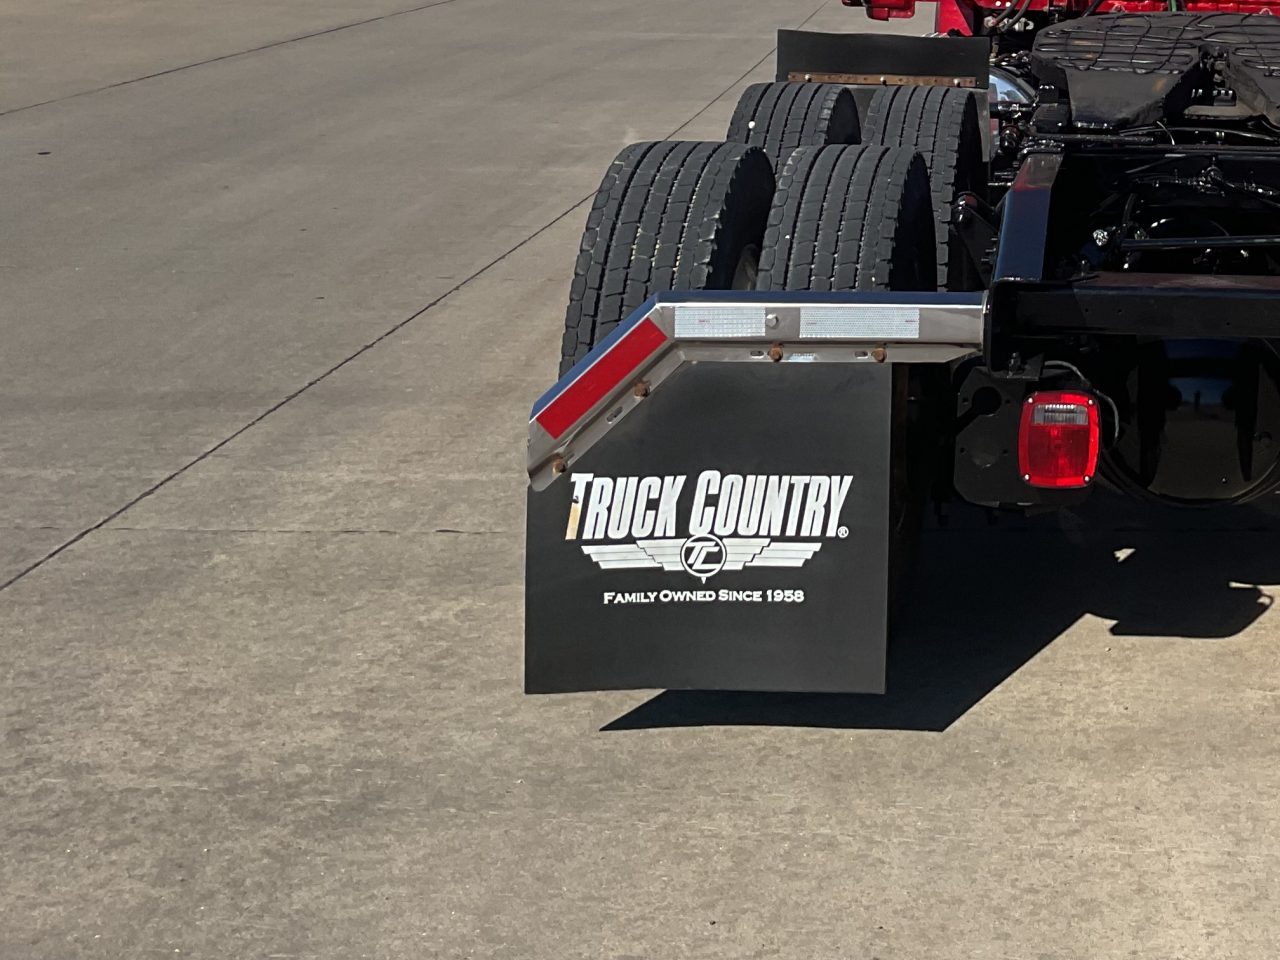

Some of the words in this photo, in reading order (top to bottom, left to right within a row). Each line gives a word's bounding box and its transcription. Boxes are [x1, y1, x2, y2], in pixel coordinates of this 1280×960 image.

[565, 473, 687, 540] TRUCK
[603, 592, 658, 605] FAMILY
[659, 589, 716, 603] OWNED
[718, 589, 762, 602] SINCE
[766, 589, 805, 603] 1958
